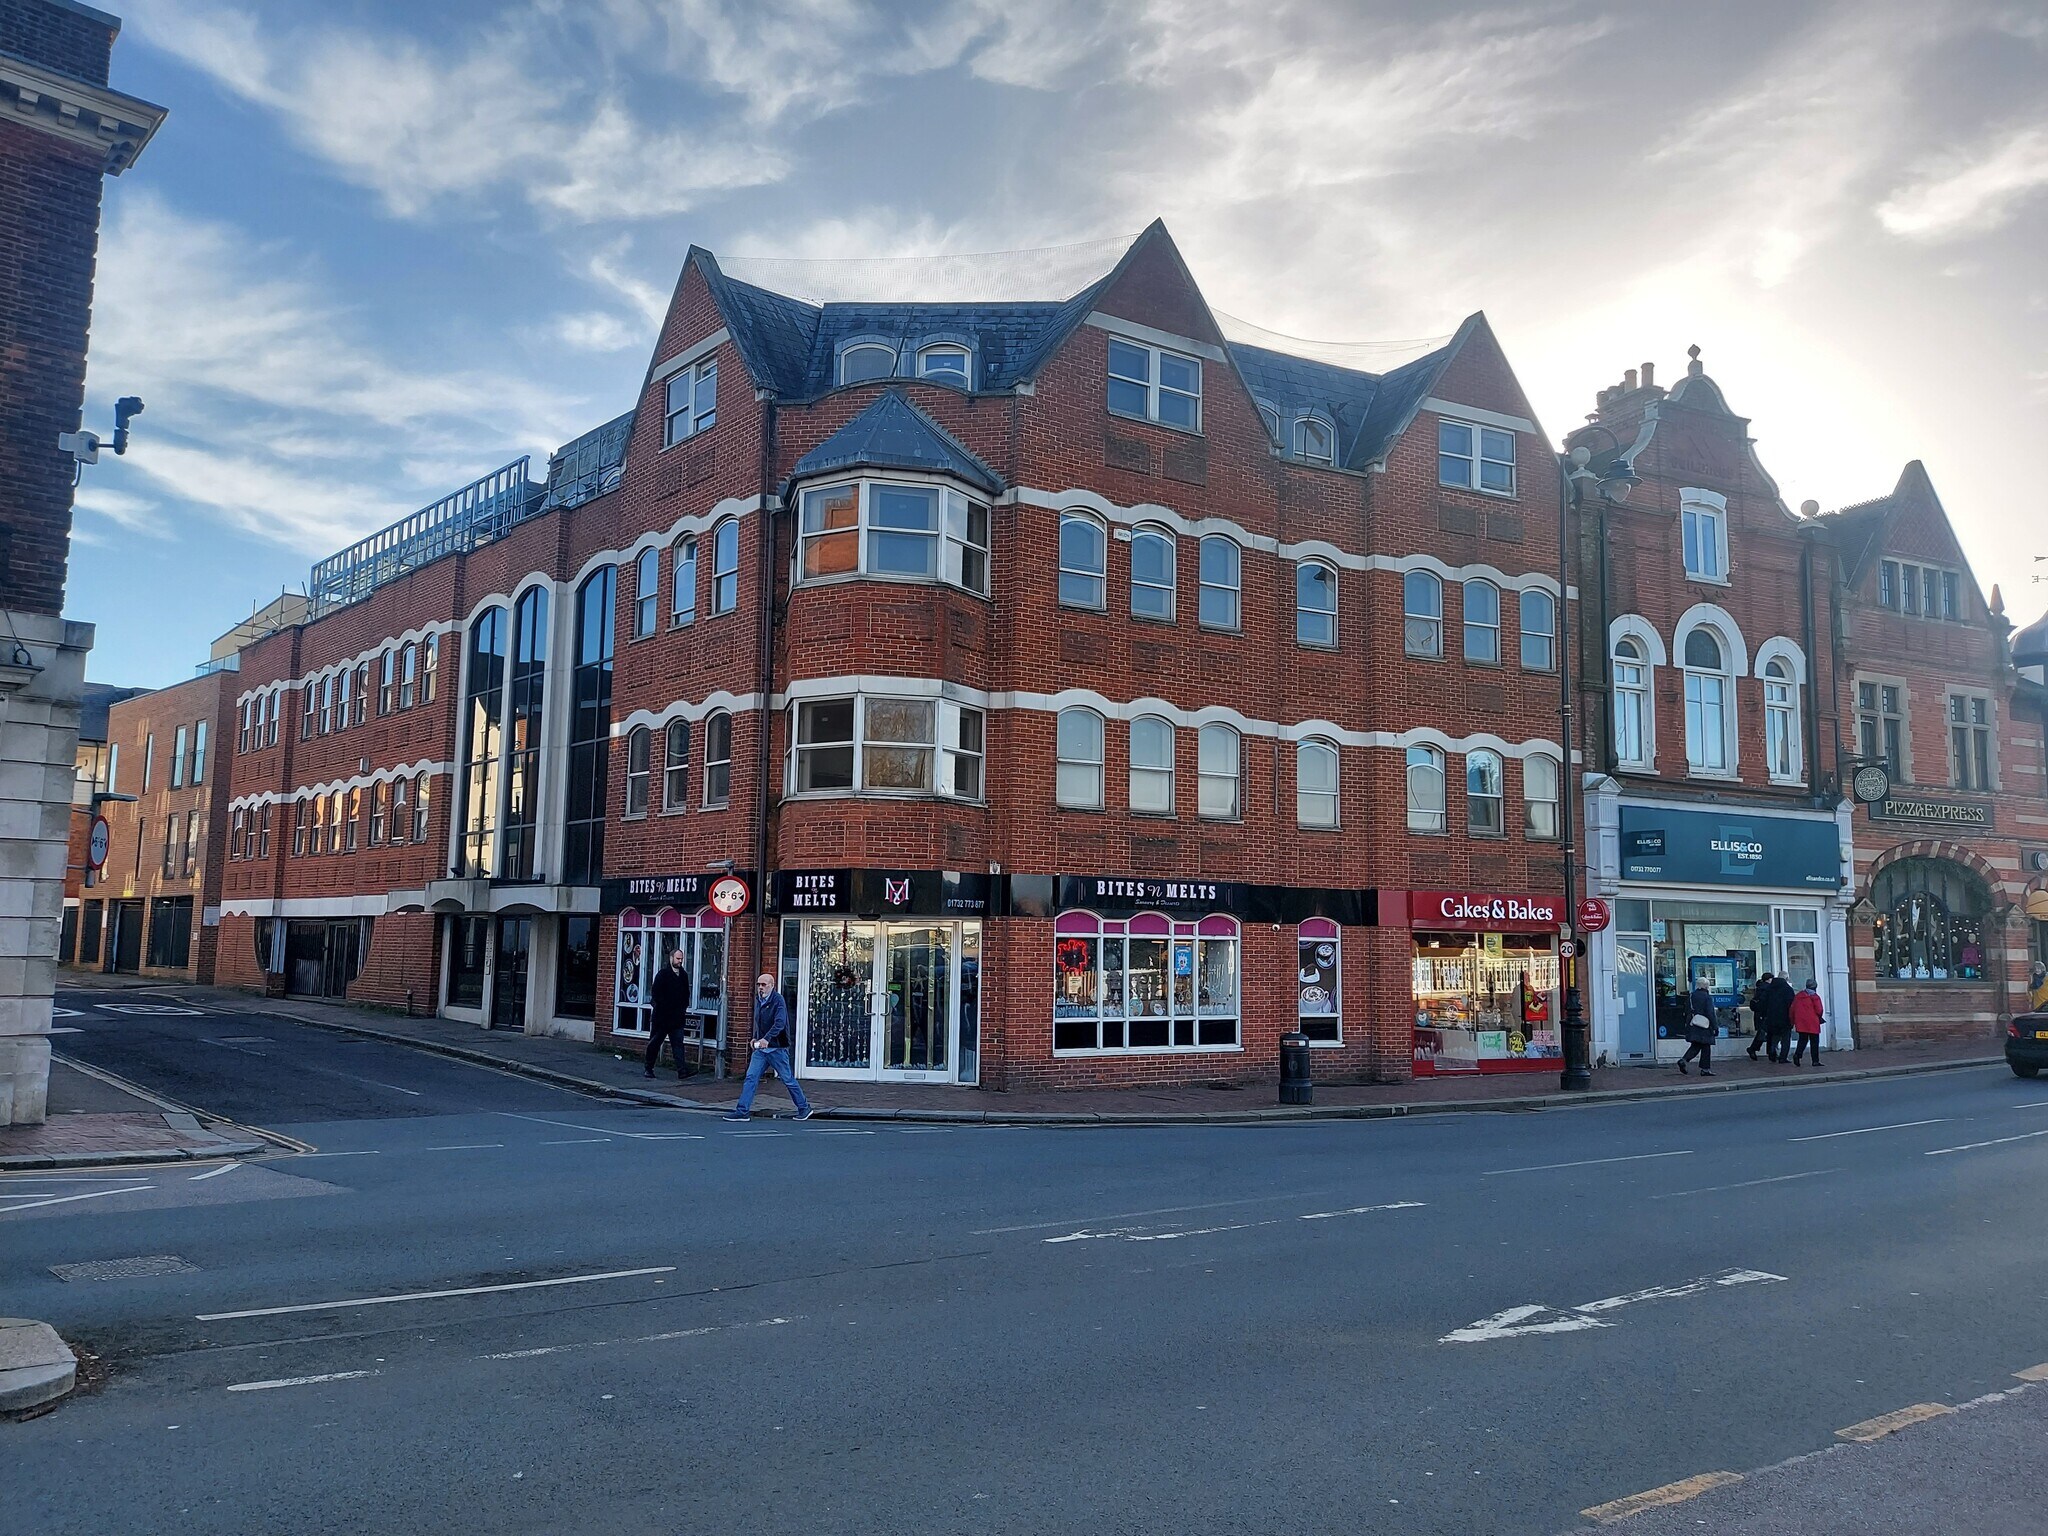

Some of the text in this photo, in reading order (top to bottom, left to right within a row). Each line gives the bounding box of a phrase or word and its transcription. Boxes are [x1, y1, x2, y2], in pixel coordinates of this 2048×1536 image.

[1711, 840, 1762, 853] ELLIS&CO
[629, 879, 656, 893] BITES
[666, 877, 698, 893] MELTS
[795, 875, 835, 888] BITES
[1097, 880, 1145, 897] BITES
[1166, 883, 1216, 900] MELTS
[793, 893, 836, 907] MELTS
[947, 898, 985, 908] 01732 773 877
[1561, 945, 1573, 954] 20
